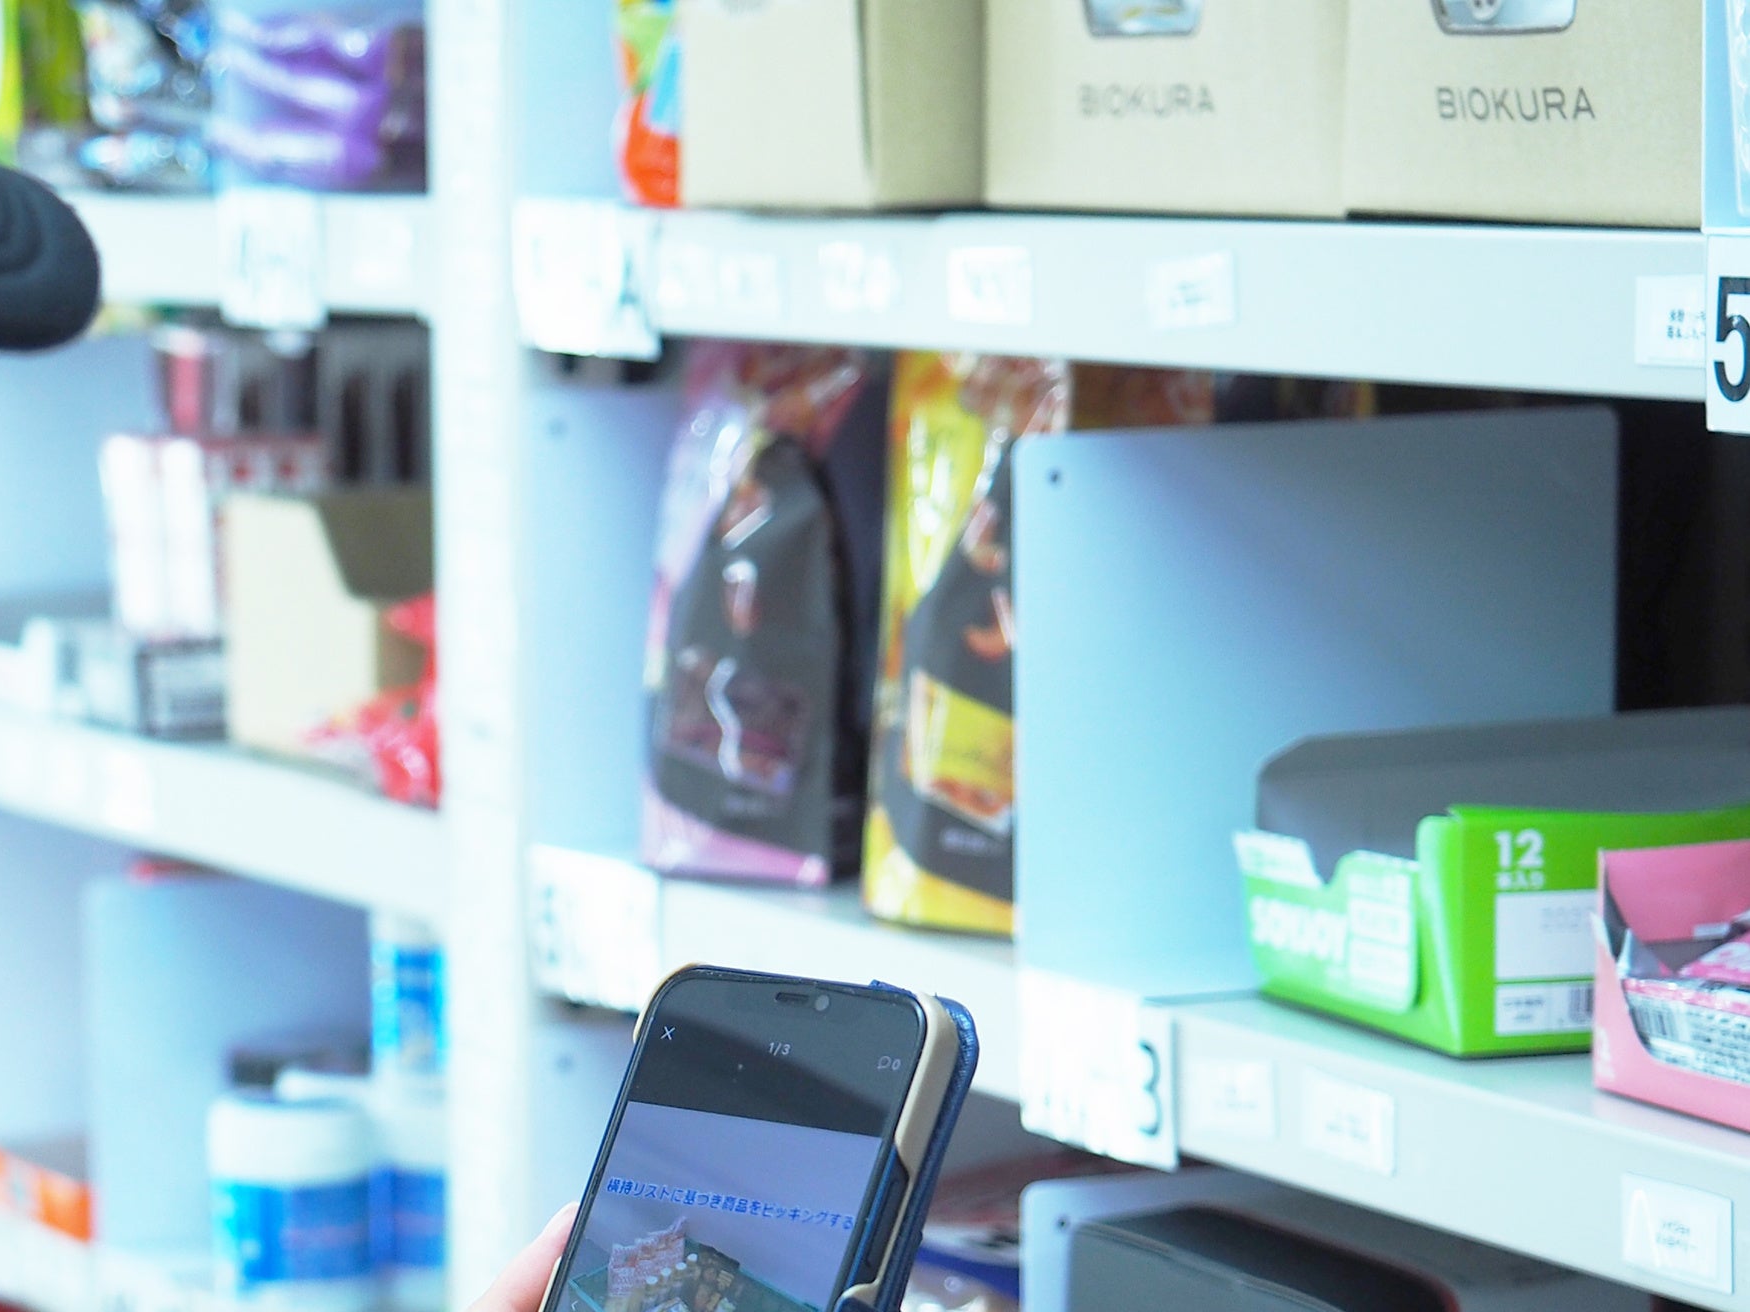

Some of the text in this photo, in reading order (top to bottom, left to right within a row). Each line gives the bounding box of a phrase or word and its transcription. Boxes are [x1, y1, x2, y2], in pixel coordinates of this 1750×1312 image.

[1077, 83, 1216, 118] BIOKURA
[1435, 86, 1596, 122] BIOKURA
[1494, 828, 1543, 868] 12
[768, 1041, 791, 1056] 1/3
[891, 1058, 901, 1071] 0
